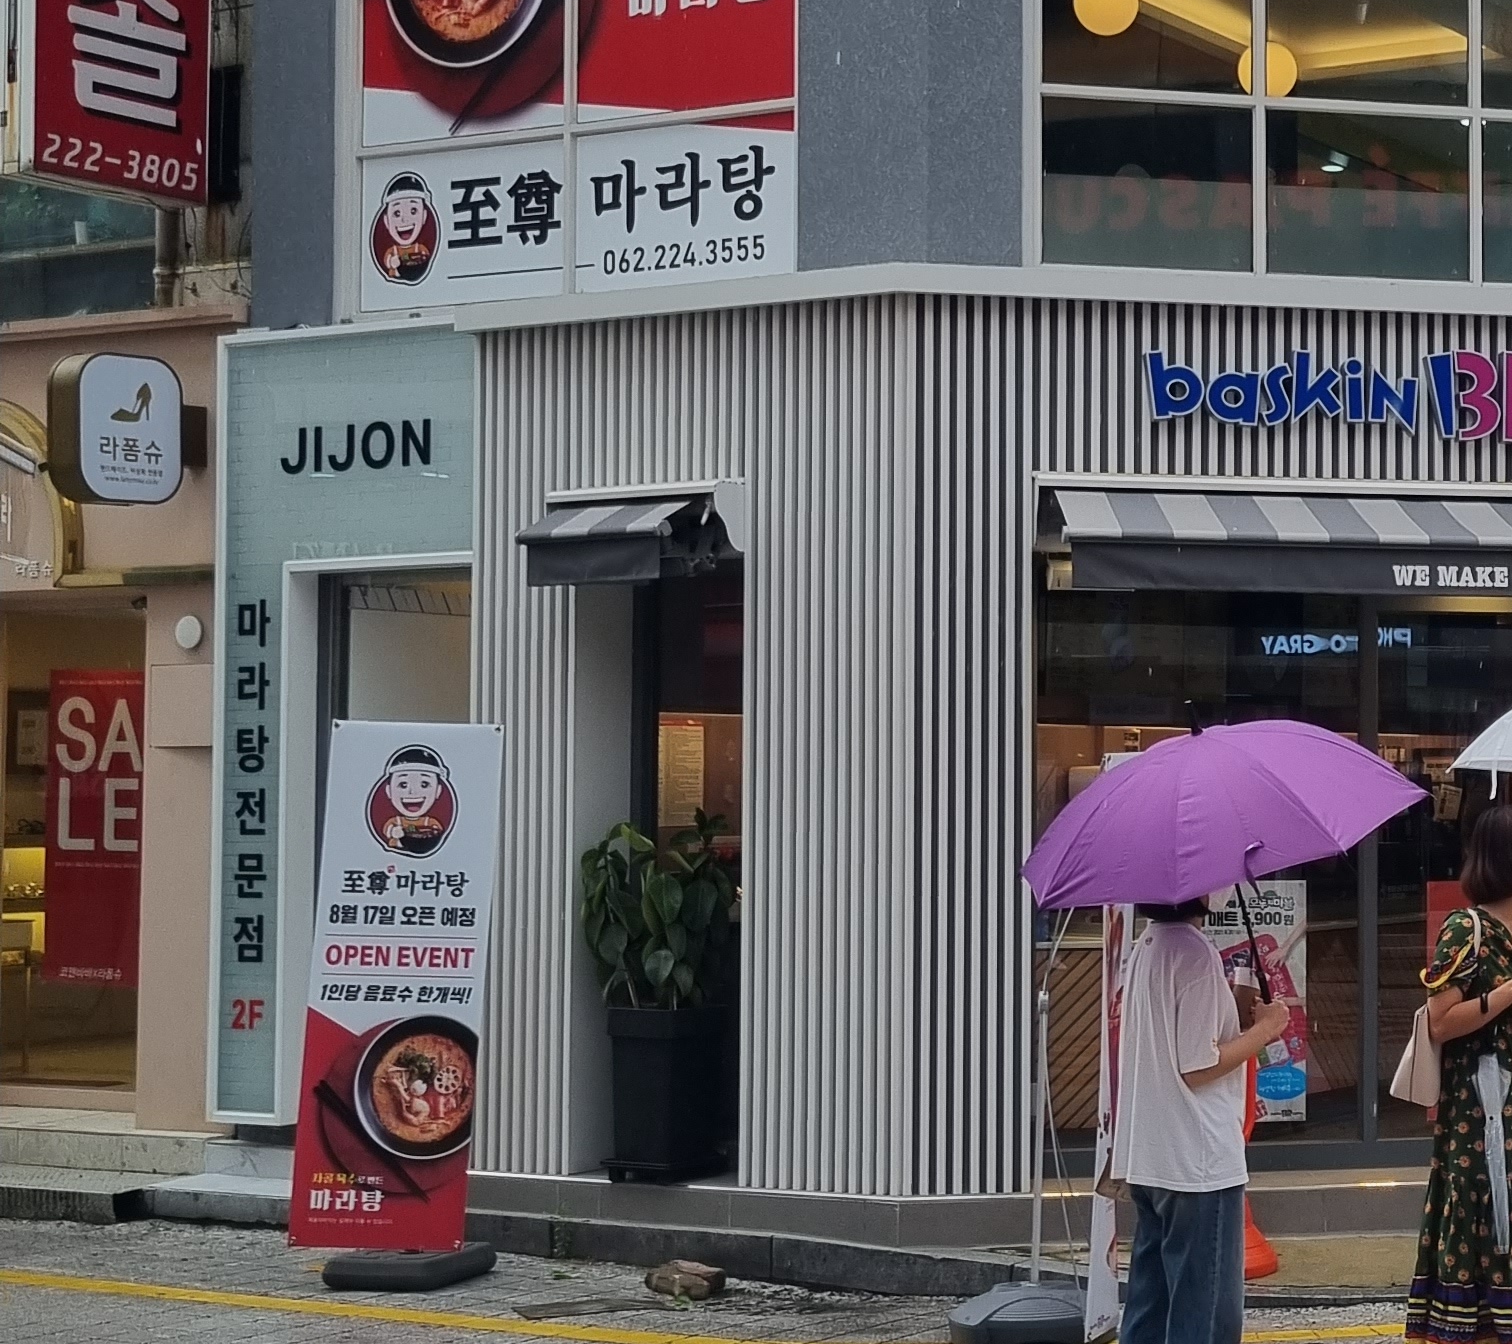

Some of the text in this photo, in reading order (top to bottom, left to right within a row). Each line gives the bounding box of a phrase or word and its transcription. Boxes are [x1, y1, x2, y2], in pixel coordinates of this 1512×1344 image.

[42, 133, 199, 191] 222-3805
[447, 145, 776, 250] 至尊 마라탕
[603, 234, 766, 276] 062.224.3555
[1144, 349, 1419, 437] baskin
[99, 435, 164, 466] 라폼슈
[280, 418, 432, 475] JIJON
[1392, 565, 1430, 587] WE
[1437, 565, 1509, 588] MAKE
[341, 870, 470, 898] 至尊 마라탕
[328, 904, 477, 928] 8월 17일 오픈 예정
[325, 943, 476, 969] OPEN EVENT
[320, 983, 473, 1005] 1인당 음료수 한개씩!
[231, 998, 265, 1030] 2F
[309, 1188, 385, 1212] 마라탕
